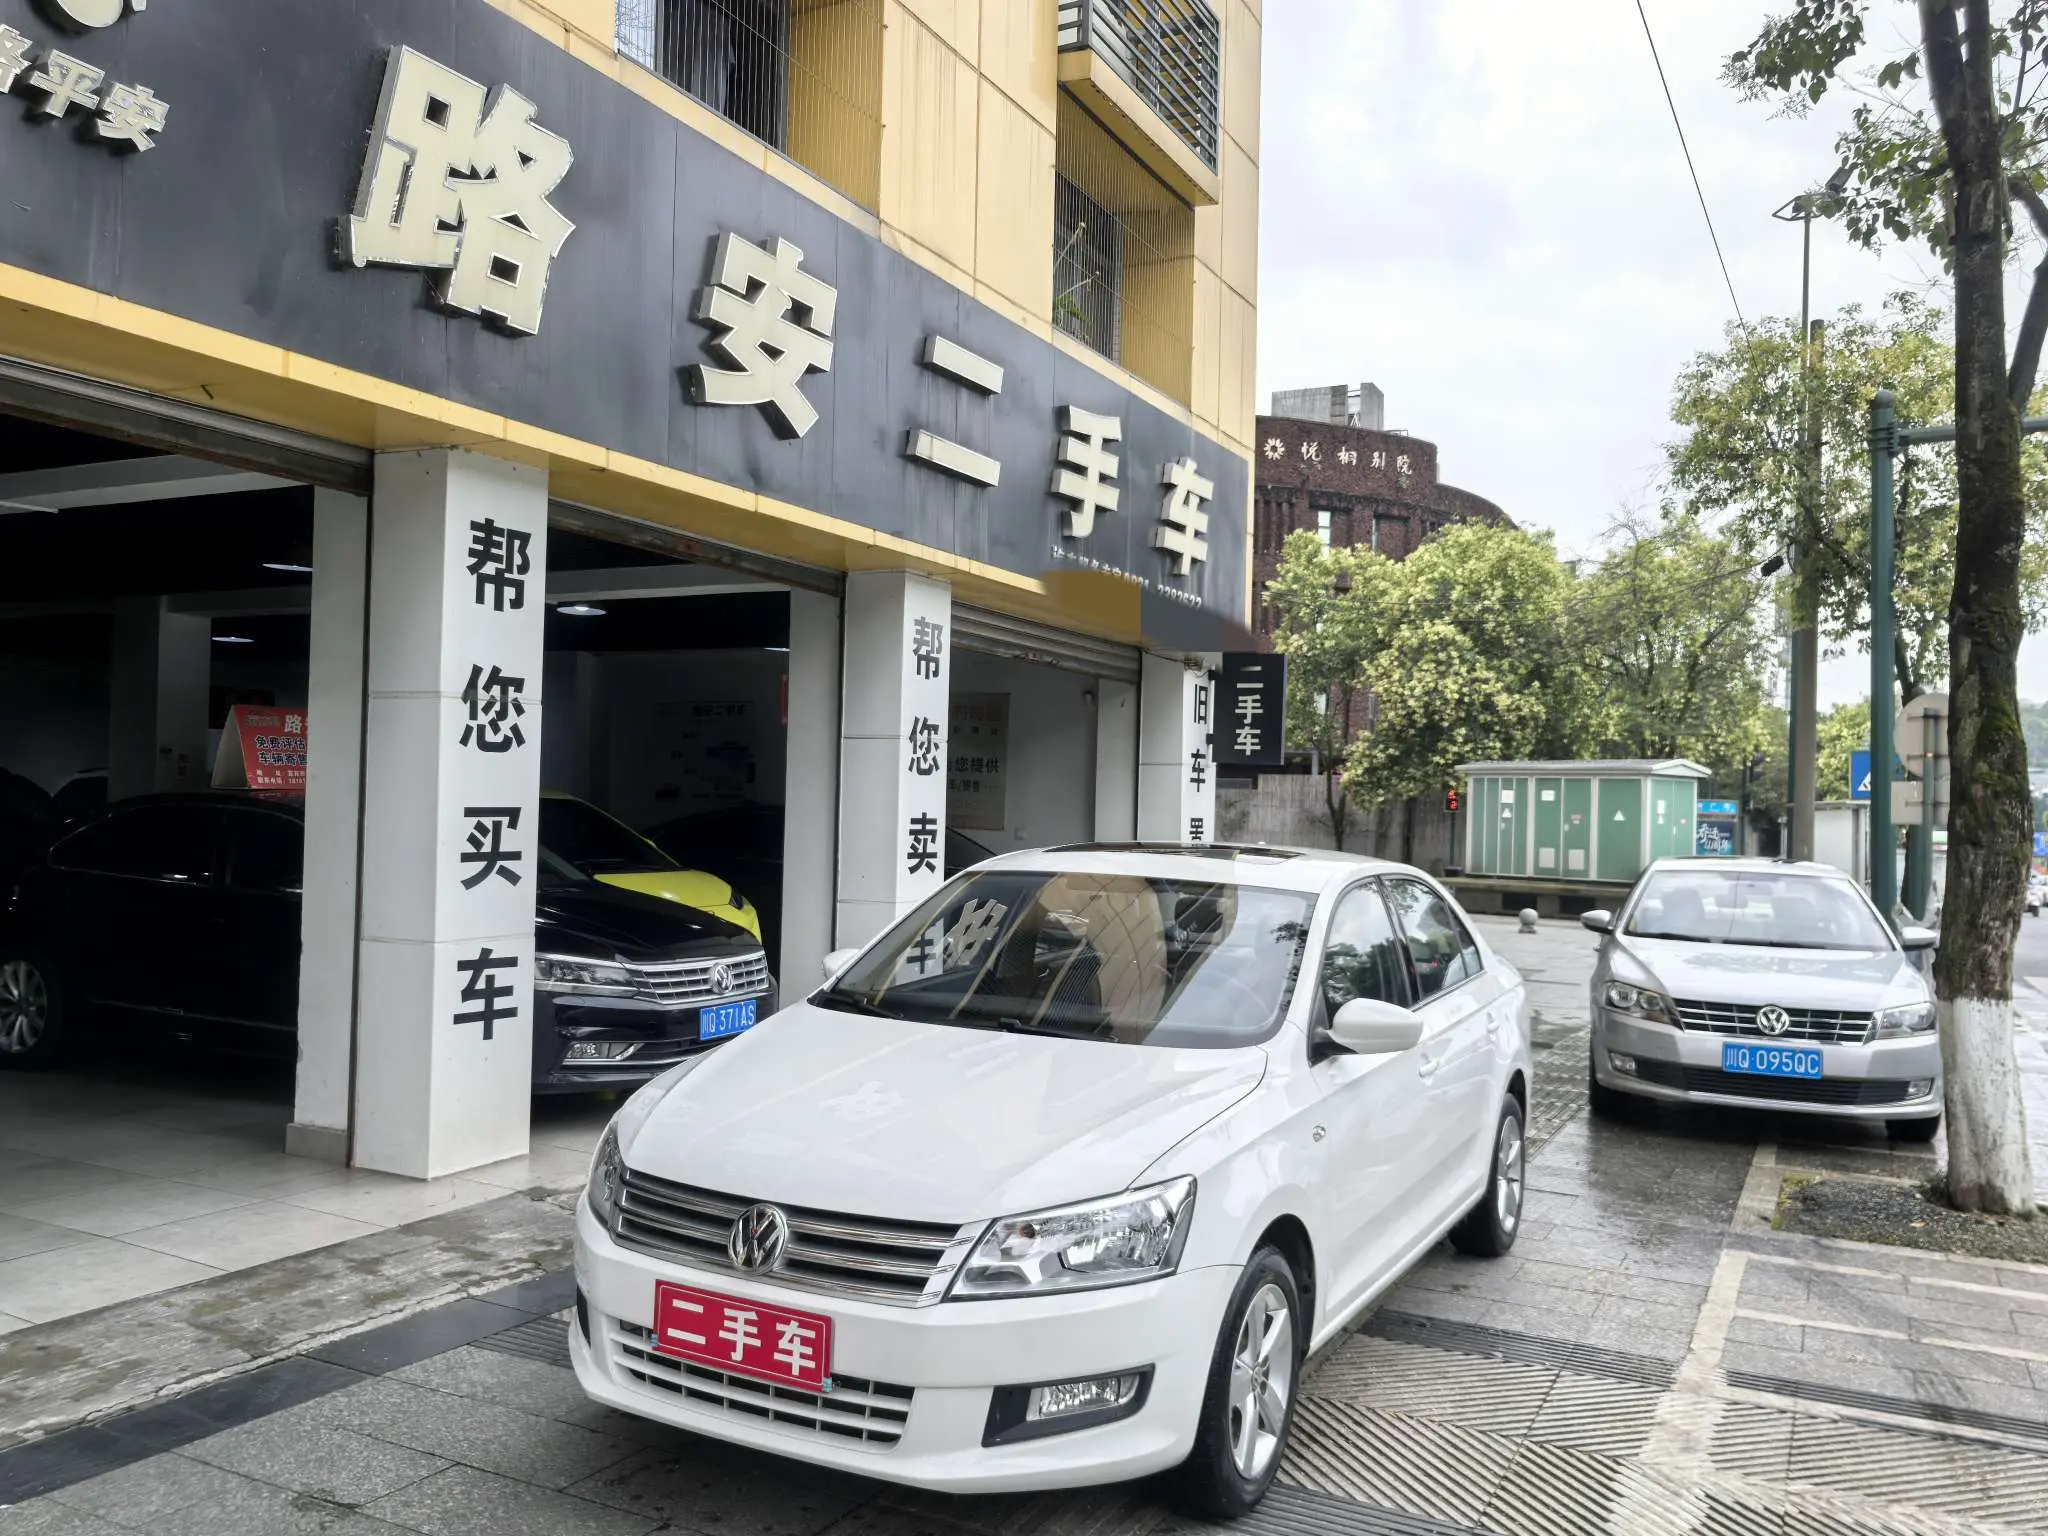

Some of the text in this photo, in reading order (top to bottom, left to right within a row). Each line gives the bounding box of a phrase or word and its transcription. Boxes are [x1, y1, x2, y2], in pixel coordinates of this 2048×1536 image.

[1234, 666, 1264, 756] 二手车
[453, 518, 533, 1041] 帮您买车
[667, 1298, 816, 1377] 二手车
